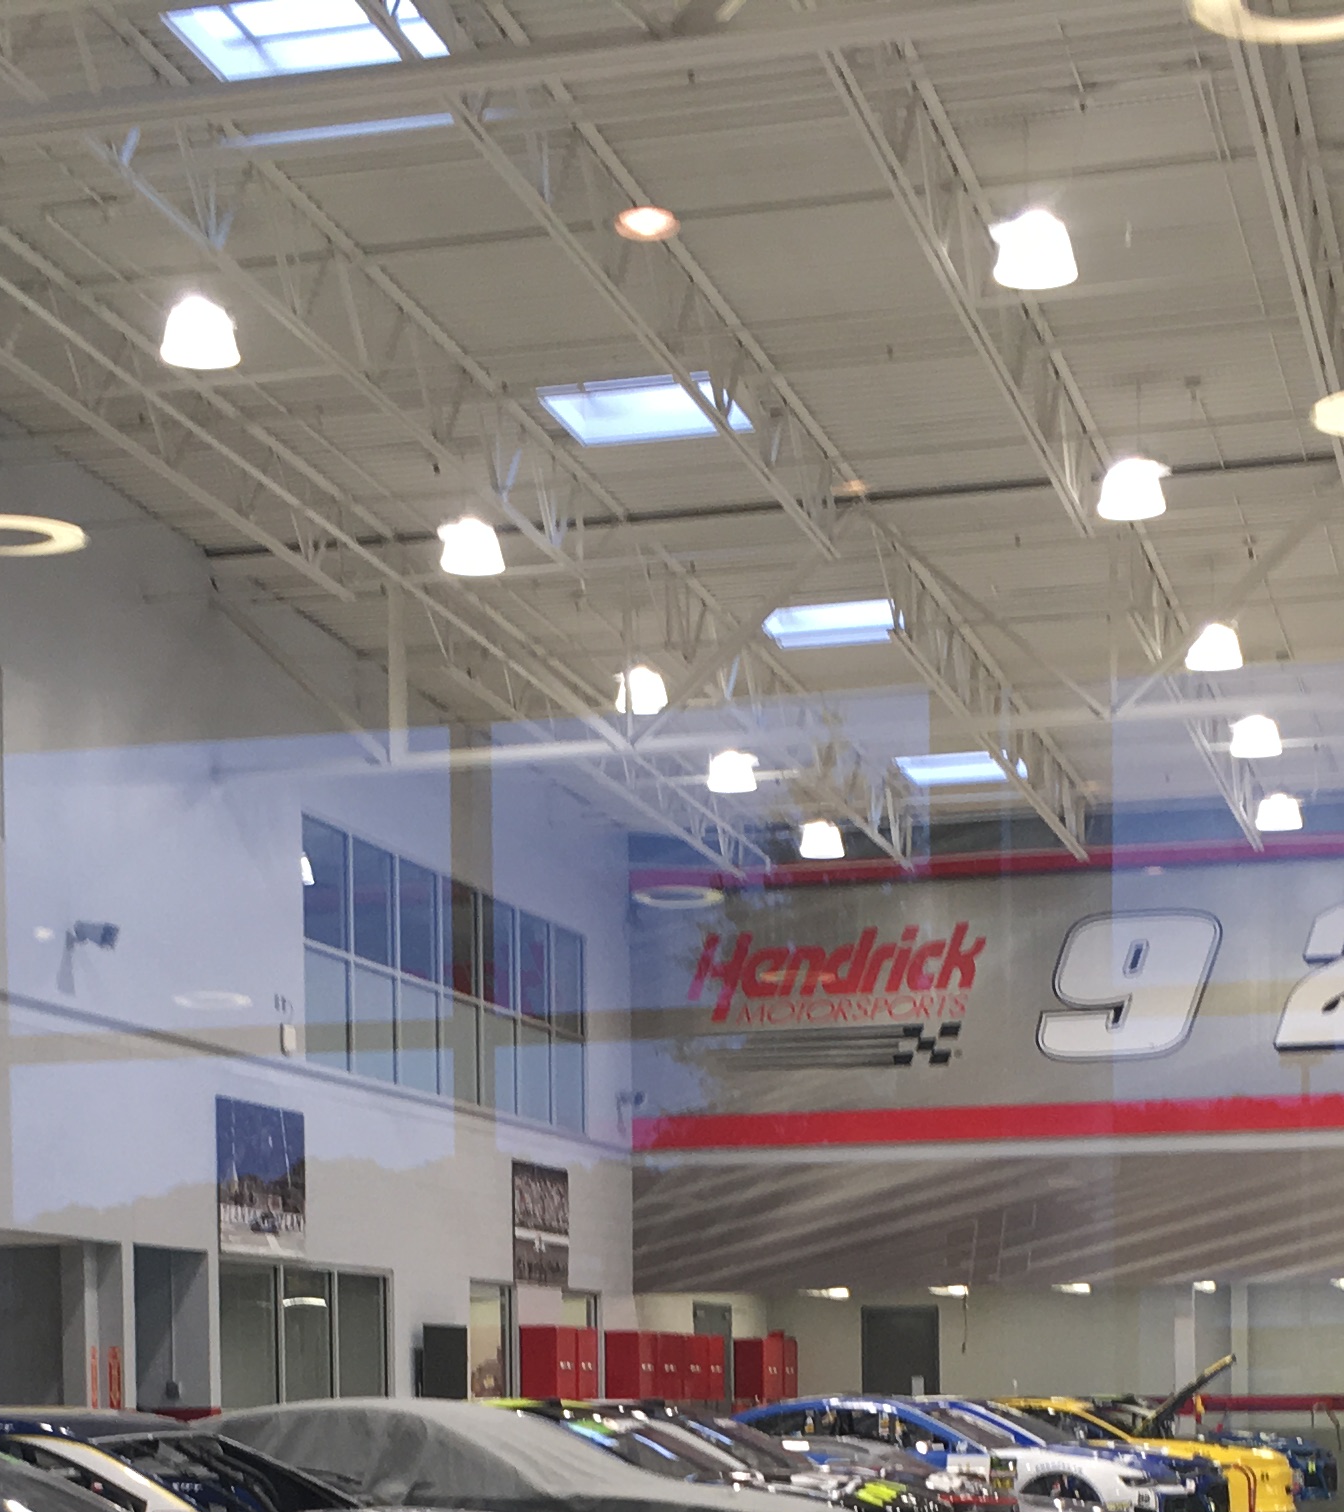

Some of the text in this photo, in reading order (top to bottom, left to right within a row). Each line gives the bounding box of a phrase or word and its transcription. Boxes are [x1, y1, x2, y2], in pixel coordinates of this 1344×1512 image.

[688, 921, 987, 1025] Hendrick
[737, 994, 968, 1027] MOTORSPORTS
[1036, 909, 1223, 1061] 9
